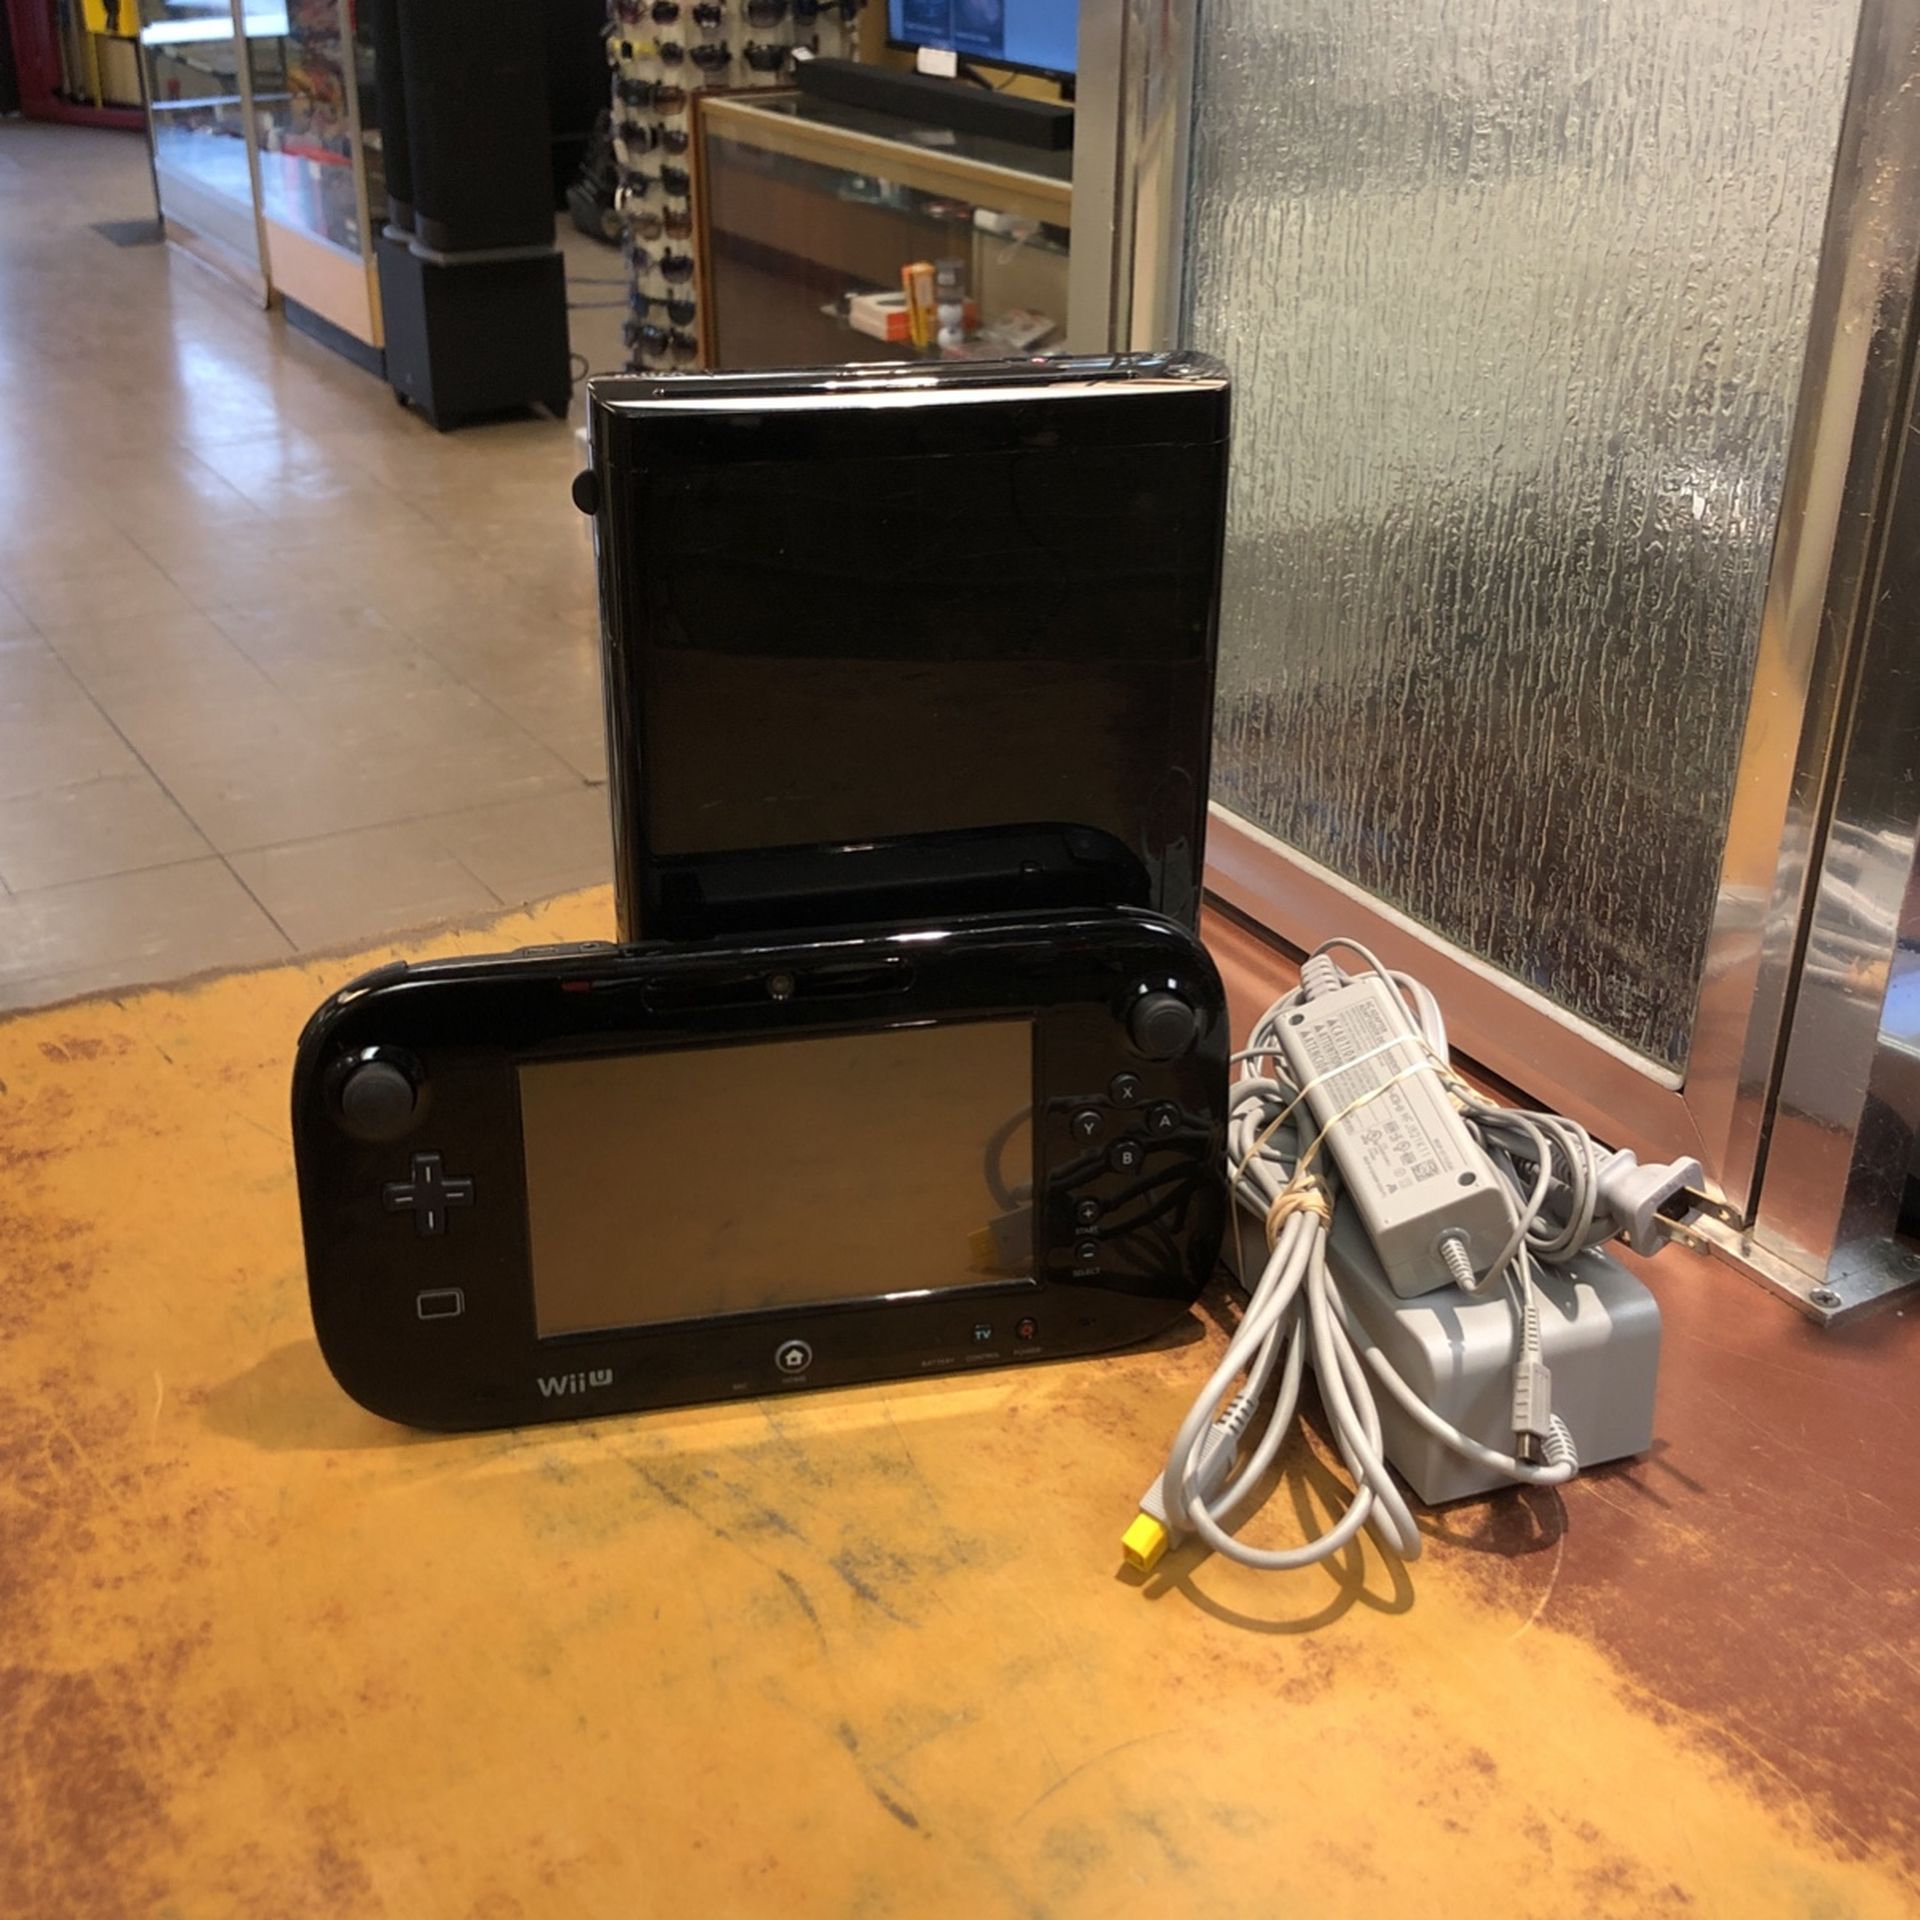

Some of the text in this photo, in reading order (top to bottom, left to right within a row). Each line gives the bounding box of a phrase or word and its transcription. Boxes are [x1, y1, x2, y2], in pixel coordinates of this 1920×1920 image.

[1122, 1087, 1133, 1098] X
[1159, 1115, 1171, 1127] A
[1084, 1122, 1094, 1135] Y
[1122, 1152, 1132, 1164] B
